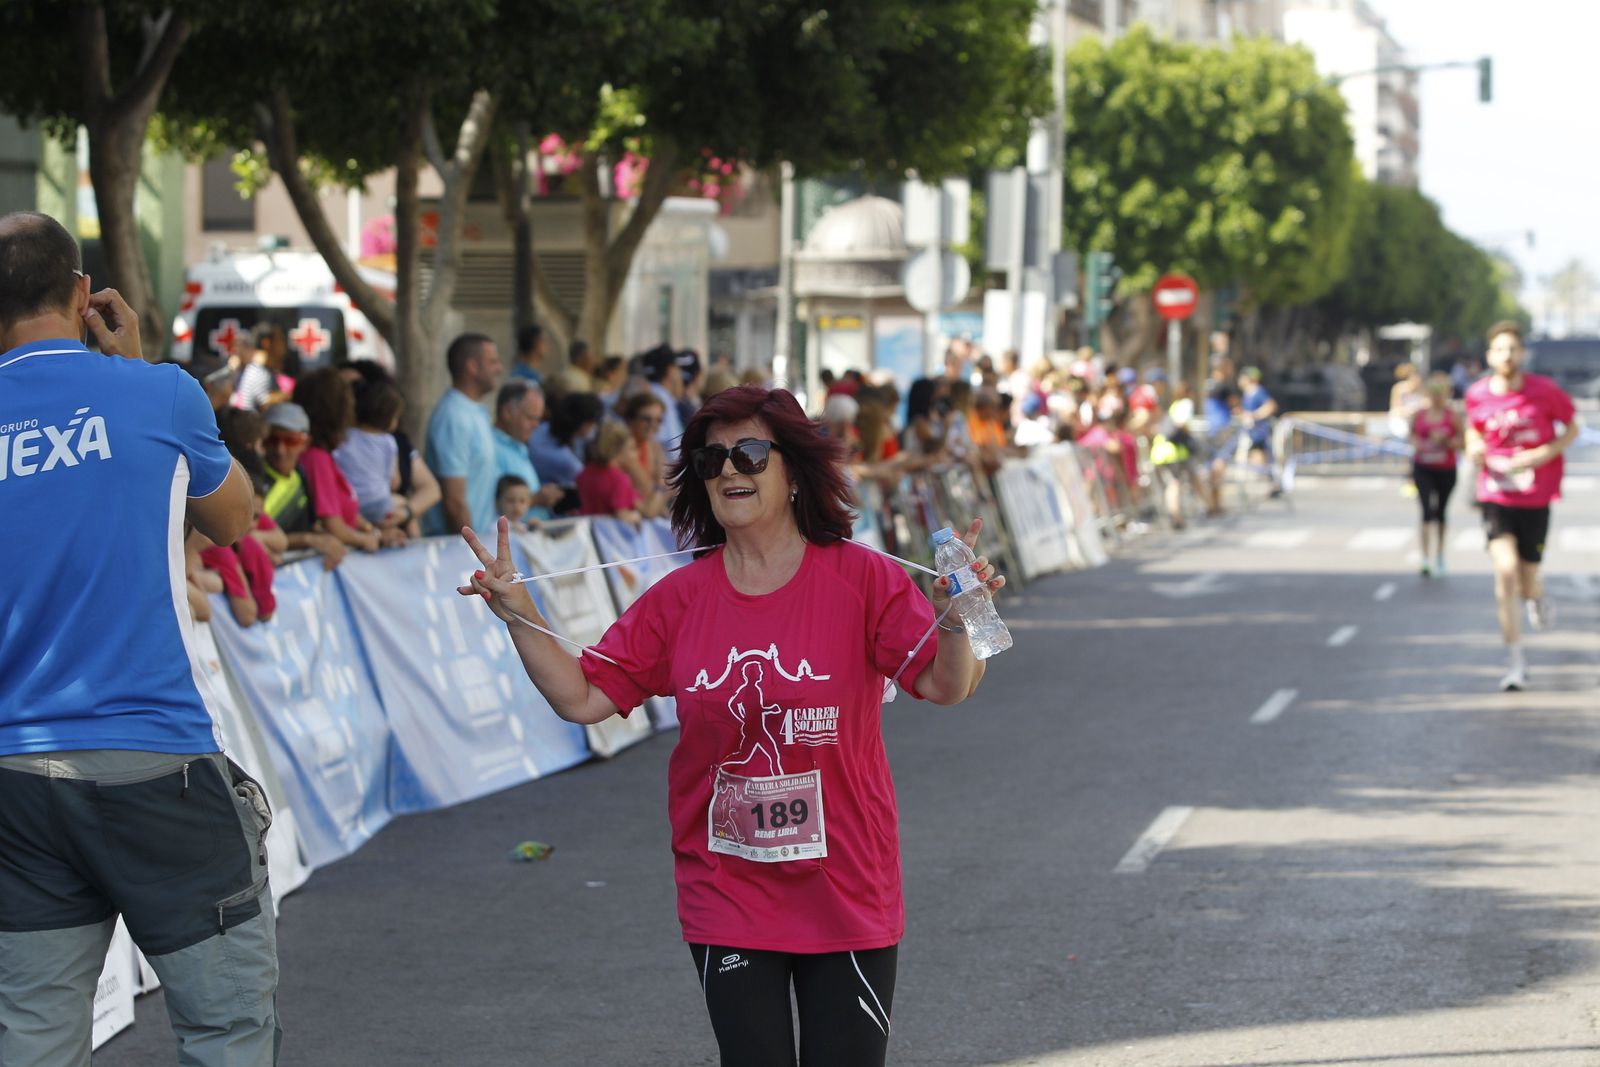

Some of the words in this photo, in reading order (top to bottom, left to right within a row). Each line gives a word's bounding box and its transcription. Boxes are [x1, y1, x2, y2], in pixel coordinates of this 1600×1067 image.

[0, 418, 39, 434] GRUPO
[779, 708, 797, 745] 4
[751, 798, 809, 830] 189
[754, 829, 776, 839] REME
[777, 826, 798, 838] LIRIA
[719, 959, 749, 973] Kalenji
